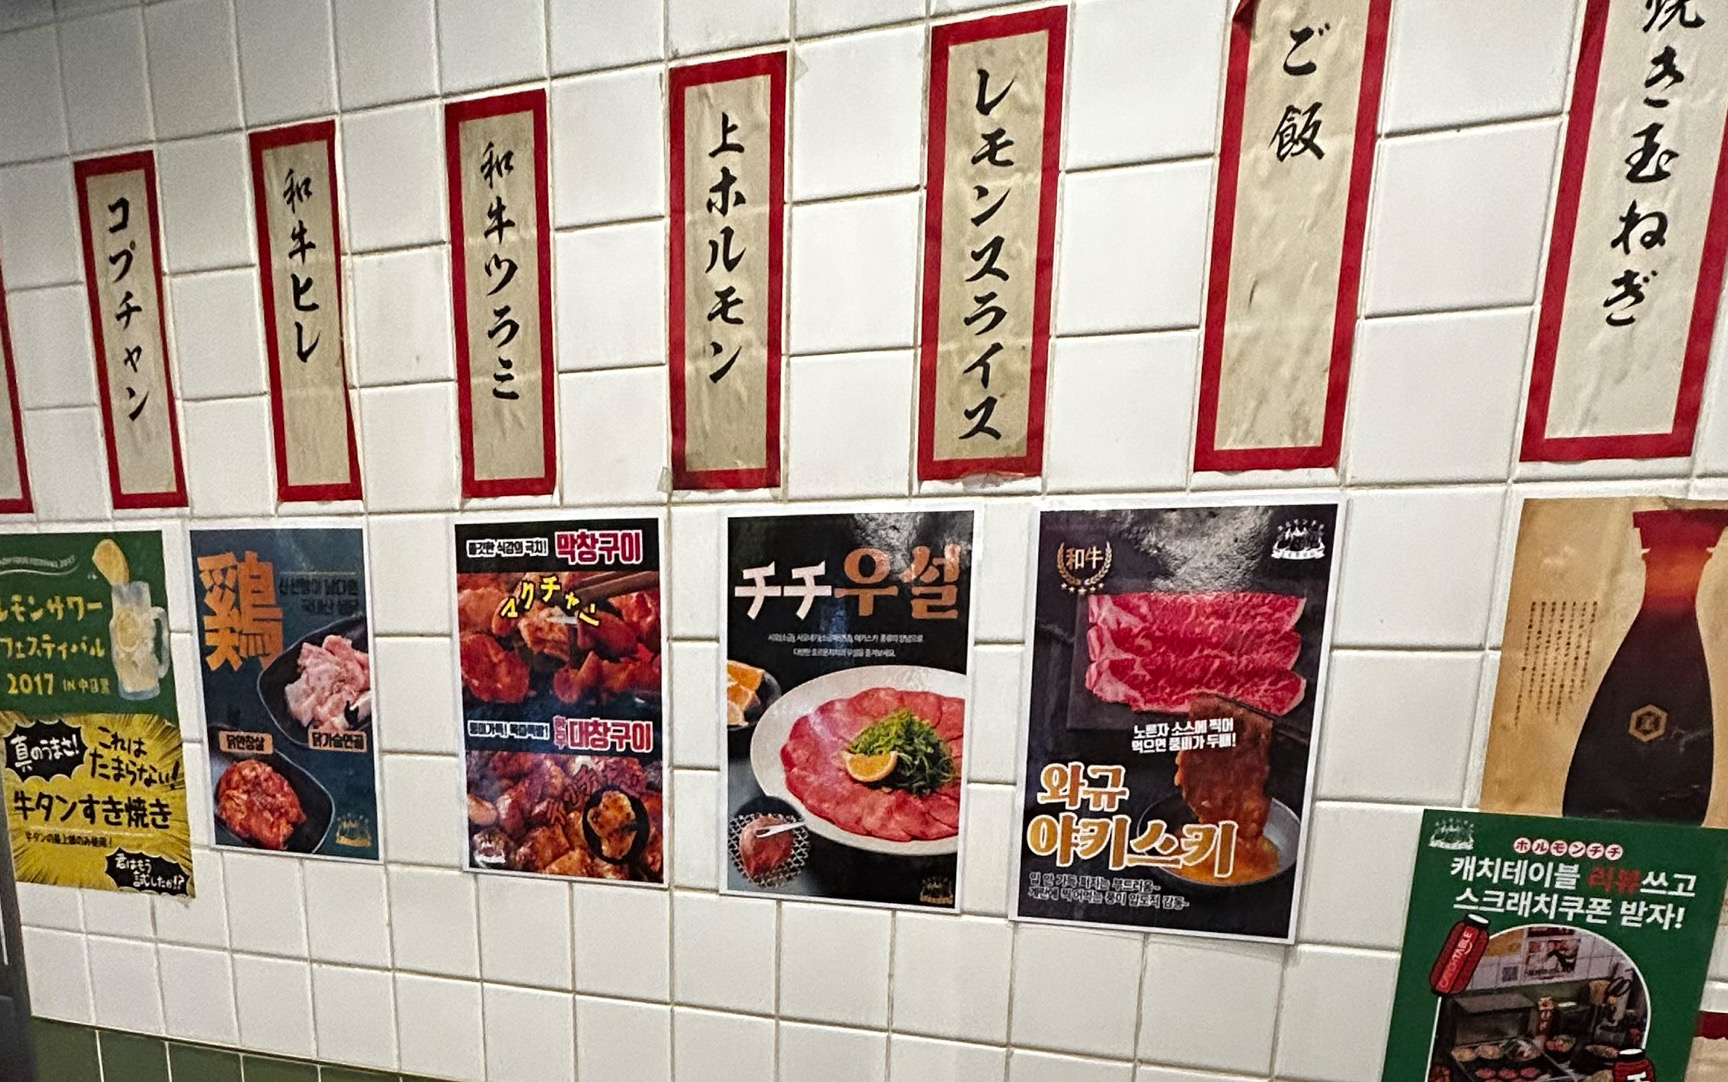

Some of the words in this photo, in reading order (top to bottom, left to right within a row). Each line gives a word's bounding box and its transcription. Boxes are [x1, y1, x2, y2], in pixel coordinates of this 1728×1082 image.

[1269, 22, 1330, 162] ご飯
[283, 169, 320, 362] 和牛ヒレ
[705, 112, 746, 384] 上ホルモン
[958, 68, 1015, 440] レモンスライス
[480, 141, 520, 400] 和牛ツラミ
[108, 197, 149, 422] コプチャン
[555, 530, 642, 564] 막창구이
[1066, 546, 1103, 569] 和牛
[500, 576, 599, 625] マクチャン
[734, 560, 832, 620] チチ
[834, 544, 961, 619] 우설
[7, 673, 54, 695] 2017
[98, 726, 147, 757] これは
[569, 718, 653, 752] 대창구이
[1132, 738, 1166, 753] 먹으면
[1169, 736, 1206, 751] 풍미가
[1207, 732, 1236, 748] 두배!
[1134, 723, 1169, 739] 노른자
[1171, 720, 1207, 736] 소스에
[1209, 717, 1234, 733] 찍어
[1037, 762, 1129, 812] 와규
[14, 790, 172, 829] 牛タンすき焼き
[115, 854, 151, 872] 君はもう
[1027, 812, 1239, 878] 야키스키
[1513, 837, 1623, 860] ホルモンチチ
[1450, 855, 1580, 890] 캐치테이블
[1453, 887, 1612, 924] 스크래치쿠폰
[1620, 900, 1685, 930] 받자!
